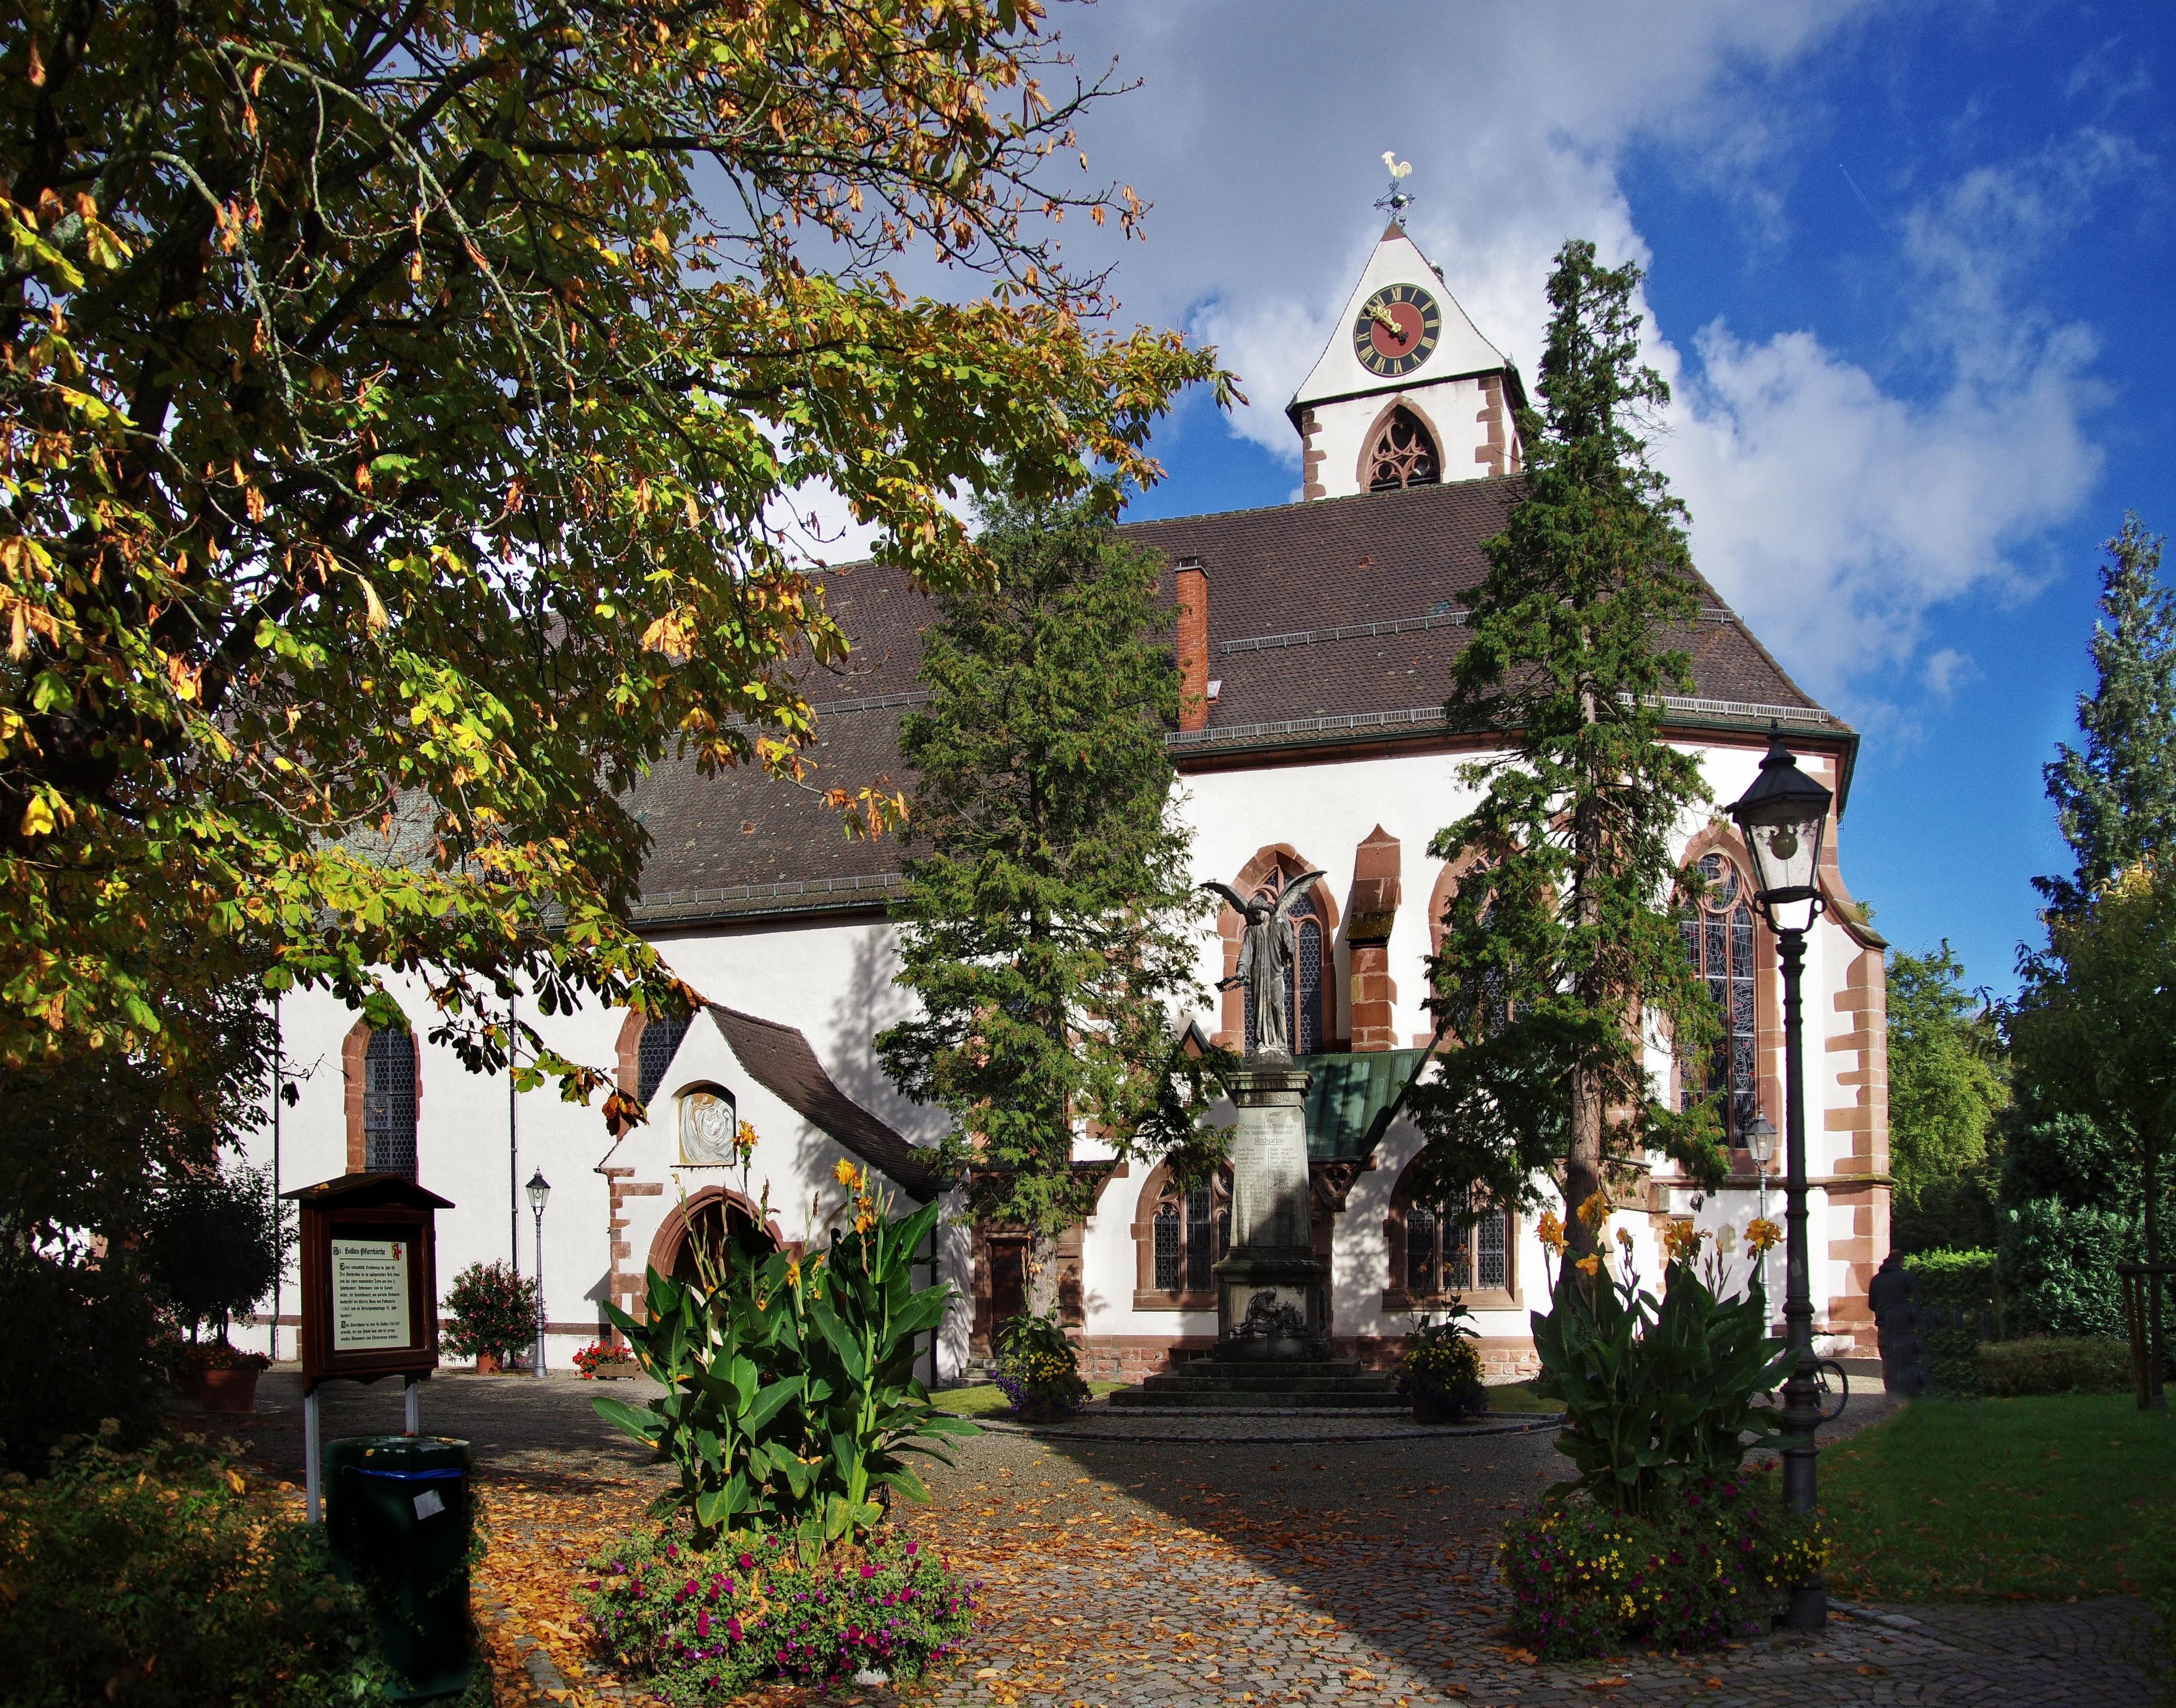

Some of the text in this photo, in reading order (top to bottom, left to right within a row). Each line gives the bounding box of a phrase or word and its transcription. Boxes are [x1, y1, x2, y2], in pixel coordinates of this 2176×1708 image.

[1391, 286, 1402, 302] XII
[1409, 288, 1418, 303] I
[1420, 300, 1434, 312] II
[1425, 318, 1439, 328] III
[1356, 332, 1370, 342] IX
[1359, 345, 1375, 363] VIII
[1412, 352, 1421, 366] V
[1373, 356, 1386, 373] VII
[1393, 359, 1402, 374] VI
[333, 1246, 343, 1256] St.
